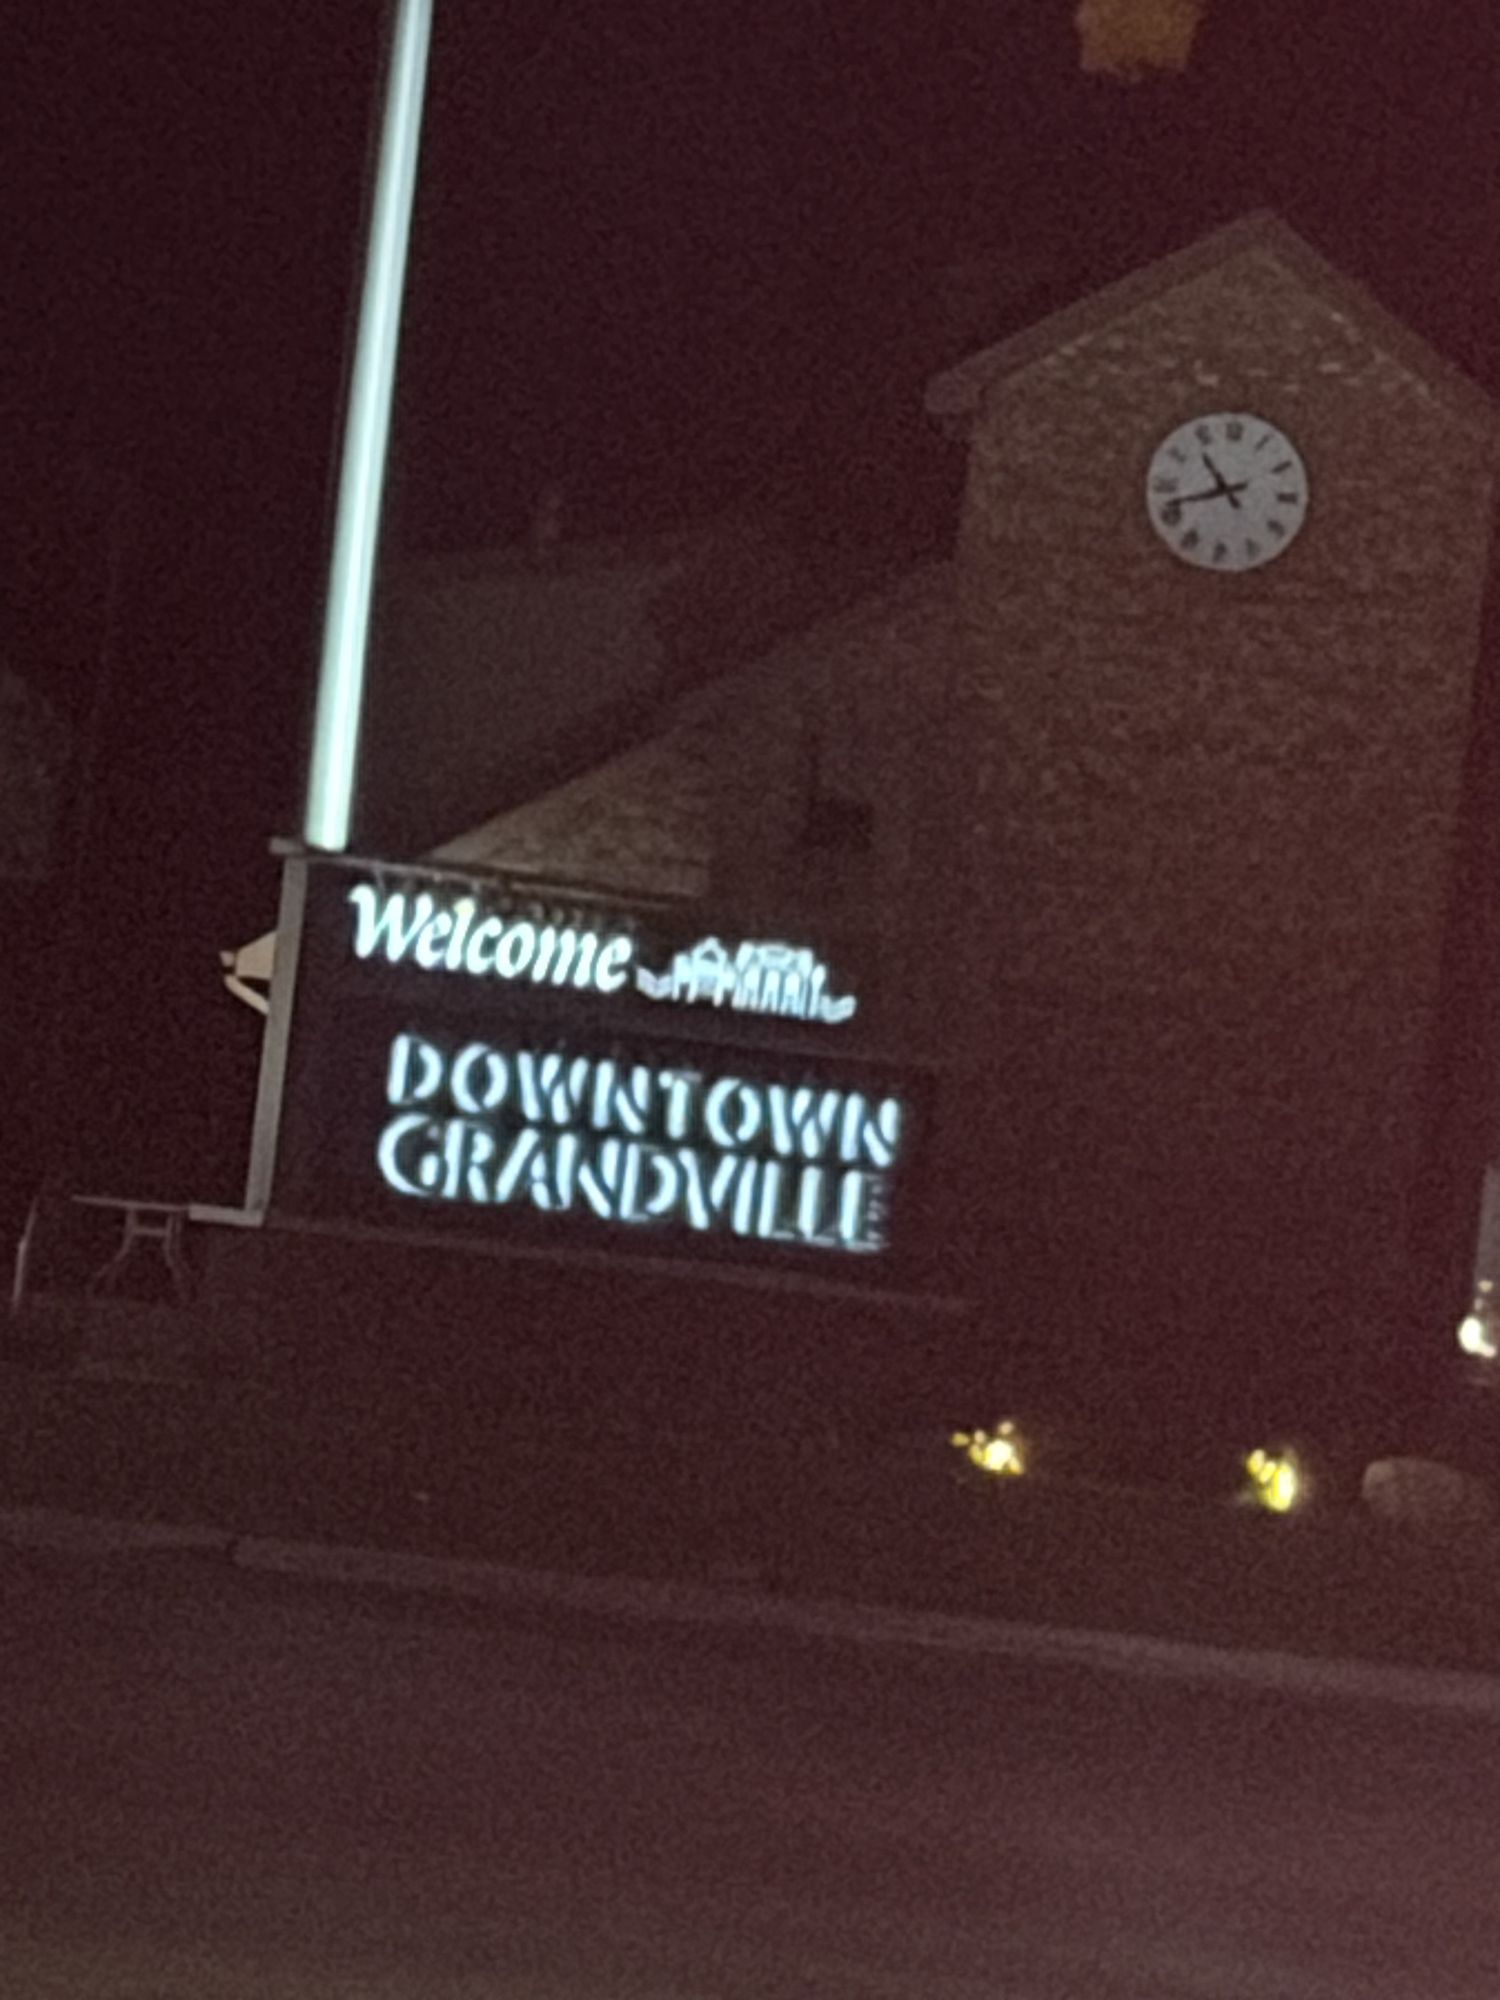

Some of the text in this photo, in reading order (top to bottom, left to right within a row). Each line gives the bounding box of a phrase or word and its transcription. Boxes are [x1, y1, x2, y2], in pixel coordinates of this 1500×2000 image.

[348, 884, 634, 992] Welcome
[386, 1033, 901, 1167] DOWNTOWN
[377, 1112, 887, 1253] GRANDVILLE
